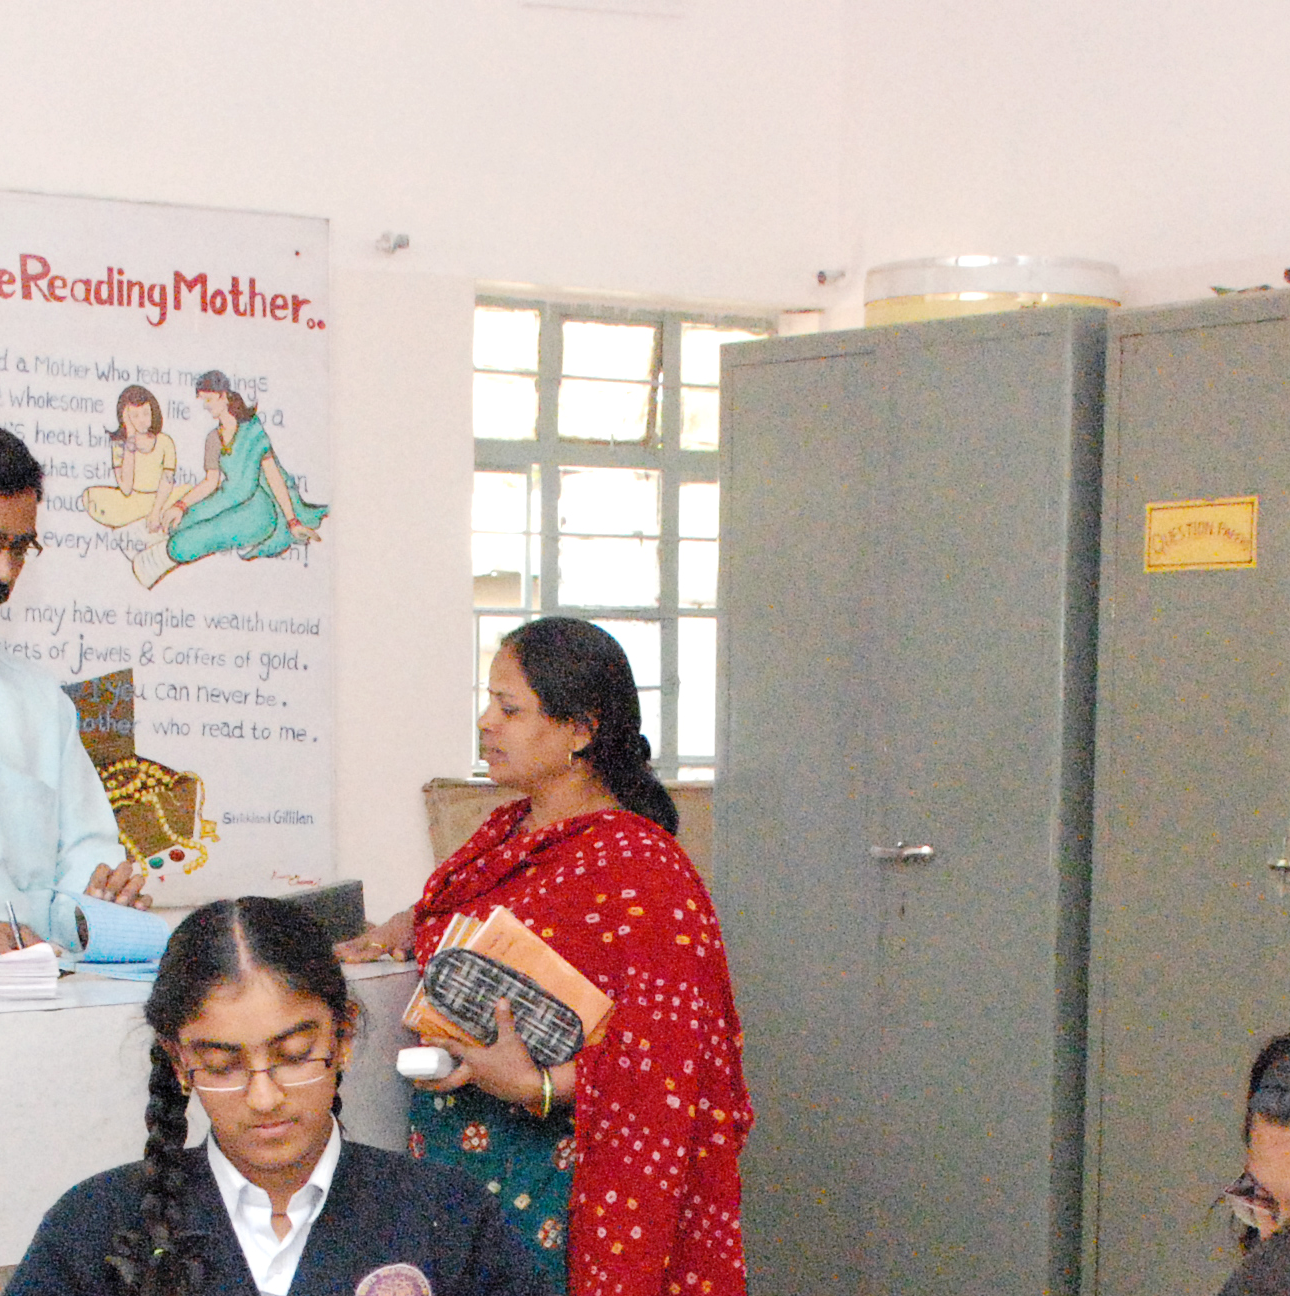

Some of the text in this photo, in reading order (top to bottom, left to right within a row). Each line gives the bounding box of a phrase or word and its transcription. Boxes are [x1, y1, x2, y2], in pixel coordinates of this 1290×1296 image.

[19, 253, 168, 327] Reading
[16, 356, 29, 373] a
[34, 355, 90, 378] Mother
[136, 364, 172, 386] read
[167, 400, 191, 420] life
[272, 409, 284, 428] a
[35, 421, 83, 445] heart
[43, 531, 92, 558] every
[25, 605, 65, 636] may
[73, 600, 117, 625] have
[126, 605, 195, 637] tangible
[204, 611, 264, 632] wealth
[268, 617, 321, 636] untold
[49, 641, 70, 660] of
[70, 633, 132, 675] jewels
[139, 640, 155, 667] &
[234, 651, 250, 668] of
[197, 684, 250, 706] never
[80, 711, 142, 736] other
[153, 718, 191, 736] who
[202, 721, 245, 740] read
[251, 722, 271, 740] to
